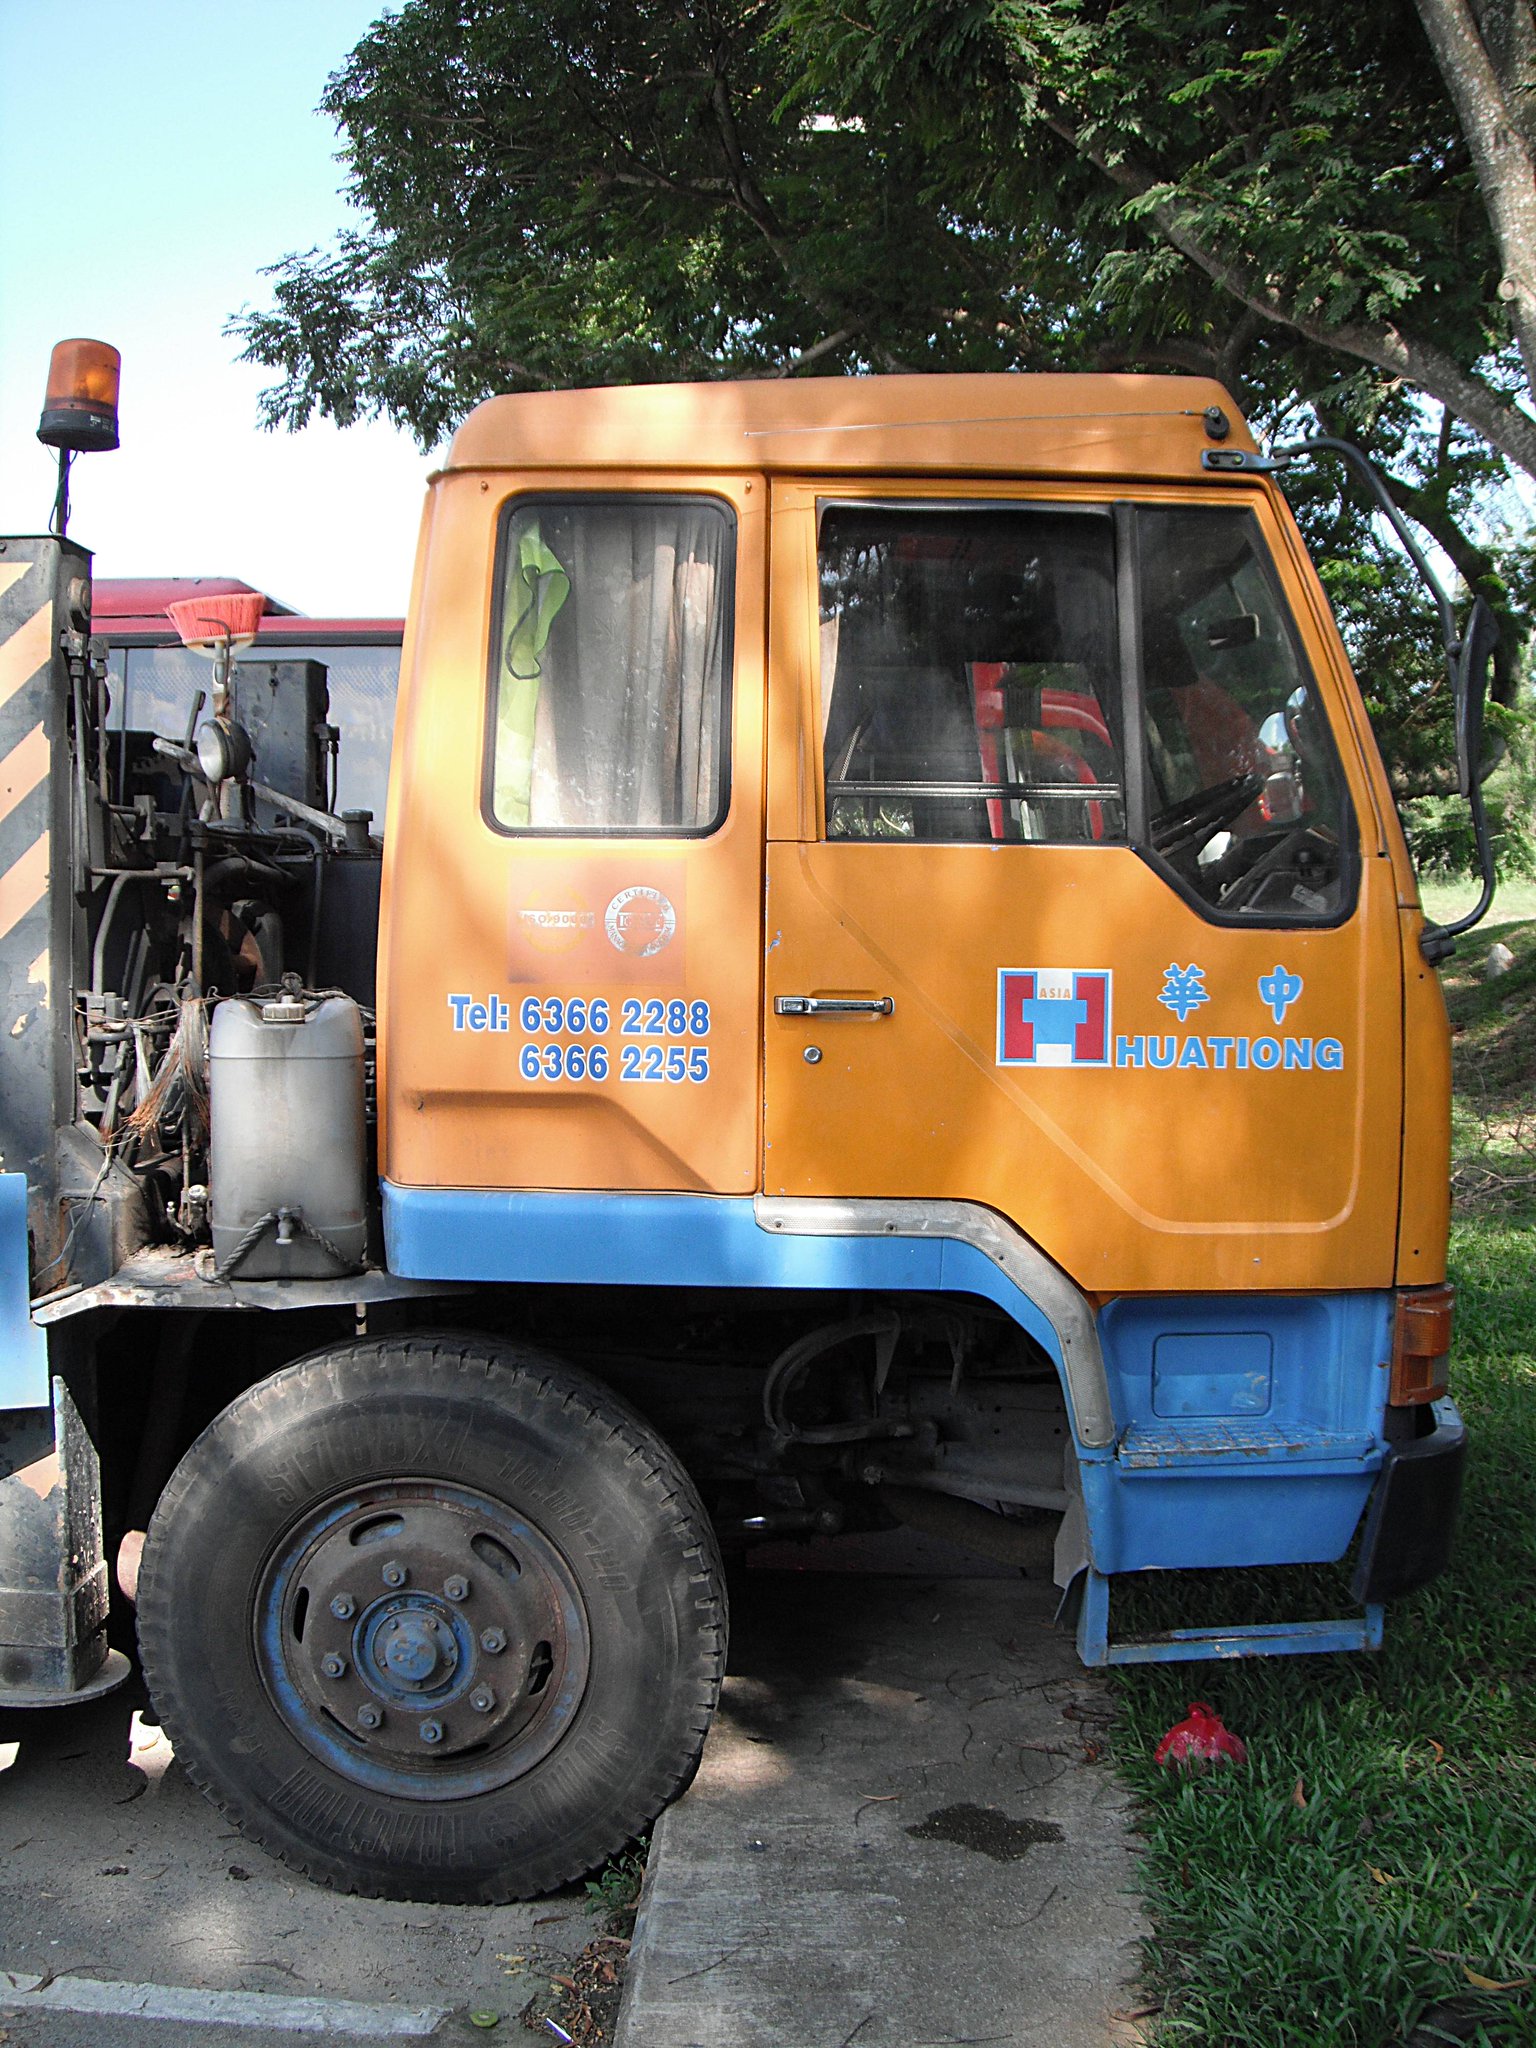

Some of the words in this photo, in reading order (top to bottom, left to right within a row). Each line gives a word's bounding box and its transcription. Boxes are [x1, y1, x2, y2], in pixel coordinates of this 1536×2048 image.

[1039, 987, 1071, 998] ASIA
[448, 993, 509, 1032] Tel:
[520, 996, 610, 1034] 6366
[620, 998, 710, 1036] 2288
[519, 1043, 609, 1081] 6366
[620, 1045, 709, 1083] 2255
[1115, 1034, 1344, 1070] HUATIONG
